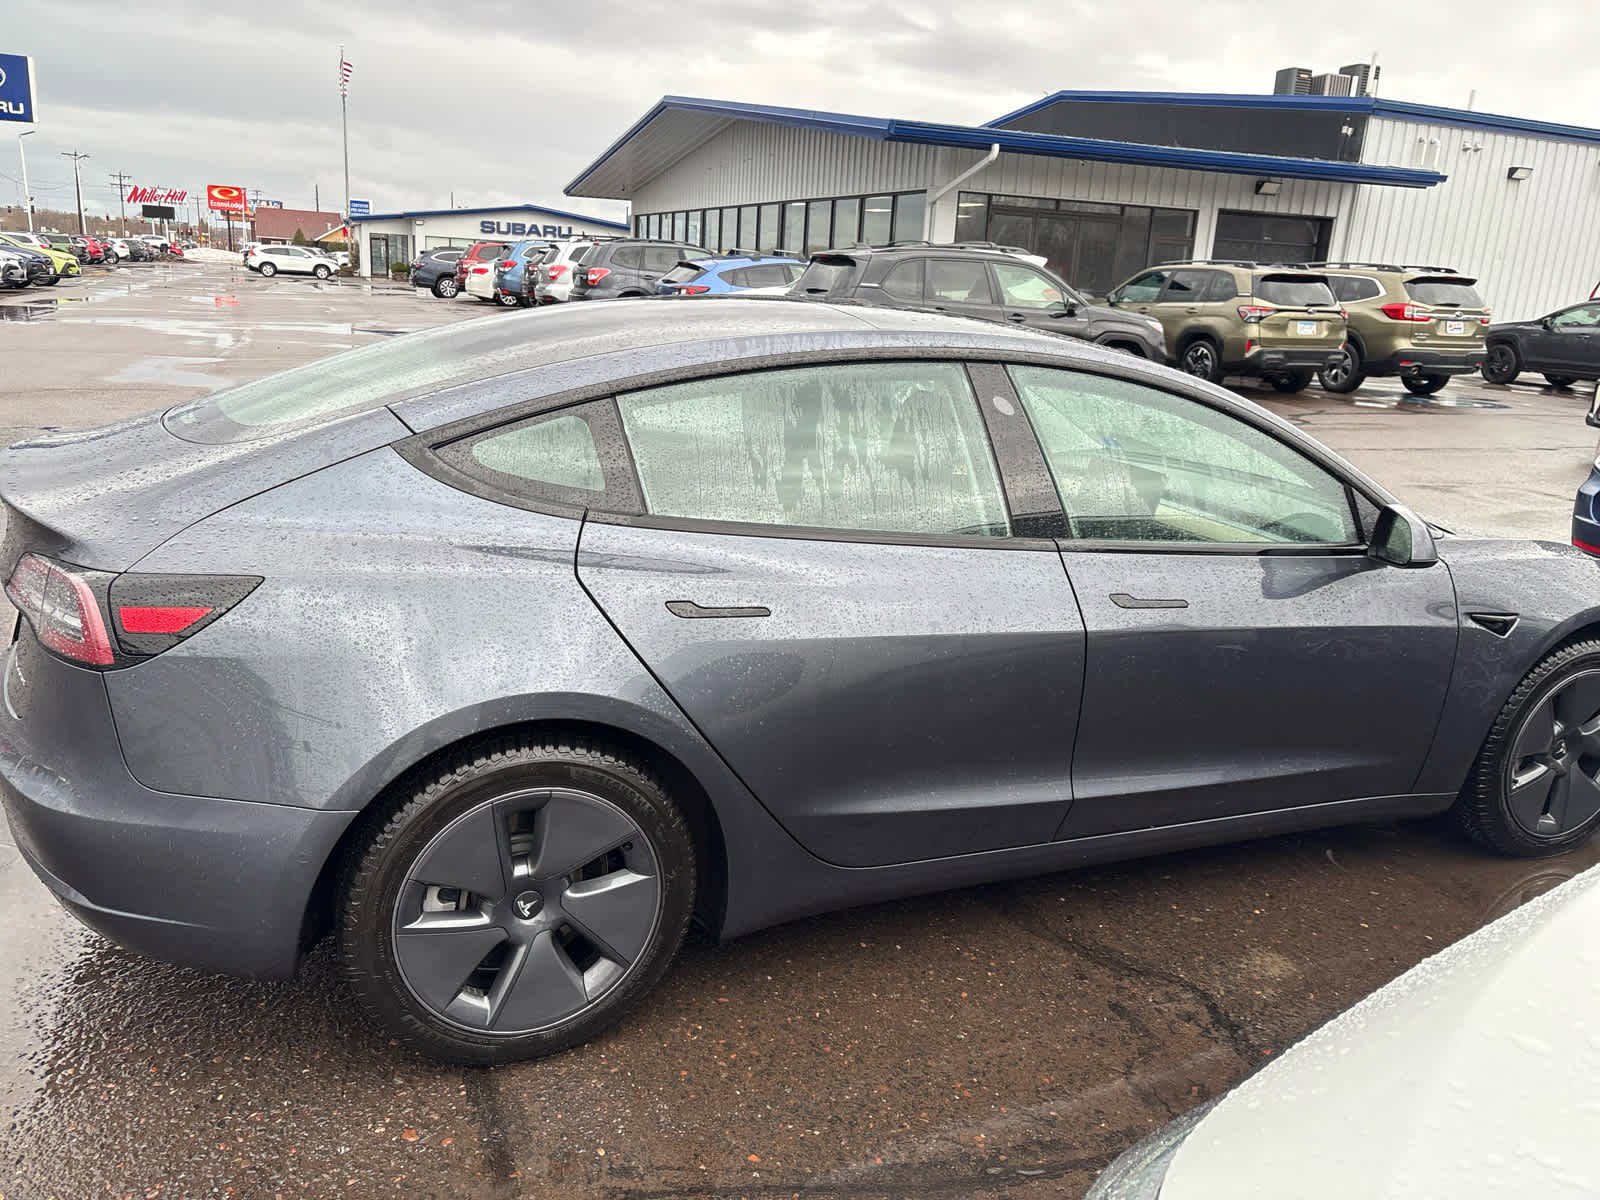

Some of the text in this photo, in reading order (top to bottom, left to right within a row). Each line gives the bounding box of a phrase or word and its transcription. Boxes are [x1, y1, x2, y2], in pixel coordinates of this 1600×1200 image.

[127, 185, 187, 203] Miller Hill
[480, 220, 572, 239] SUBARU
